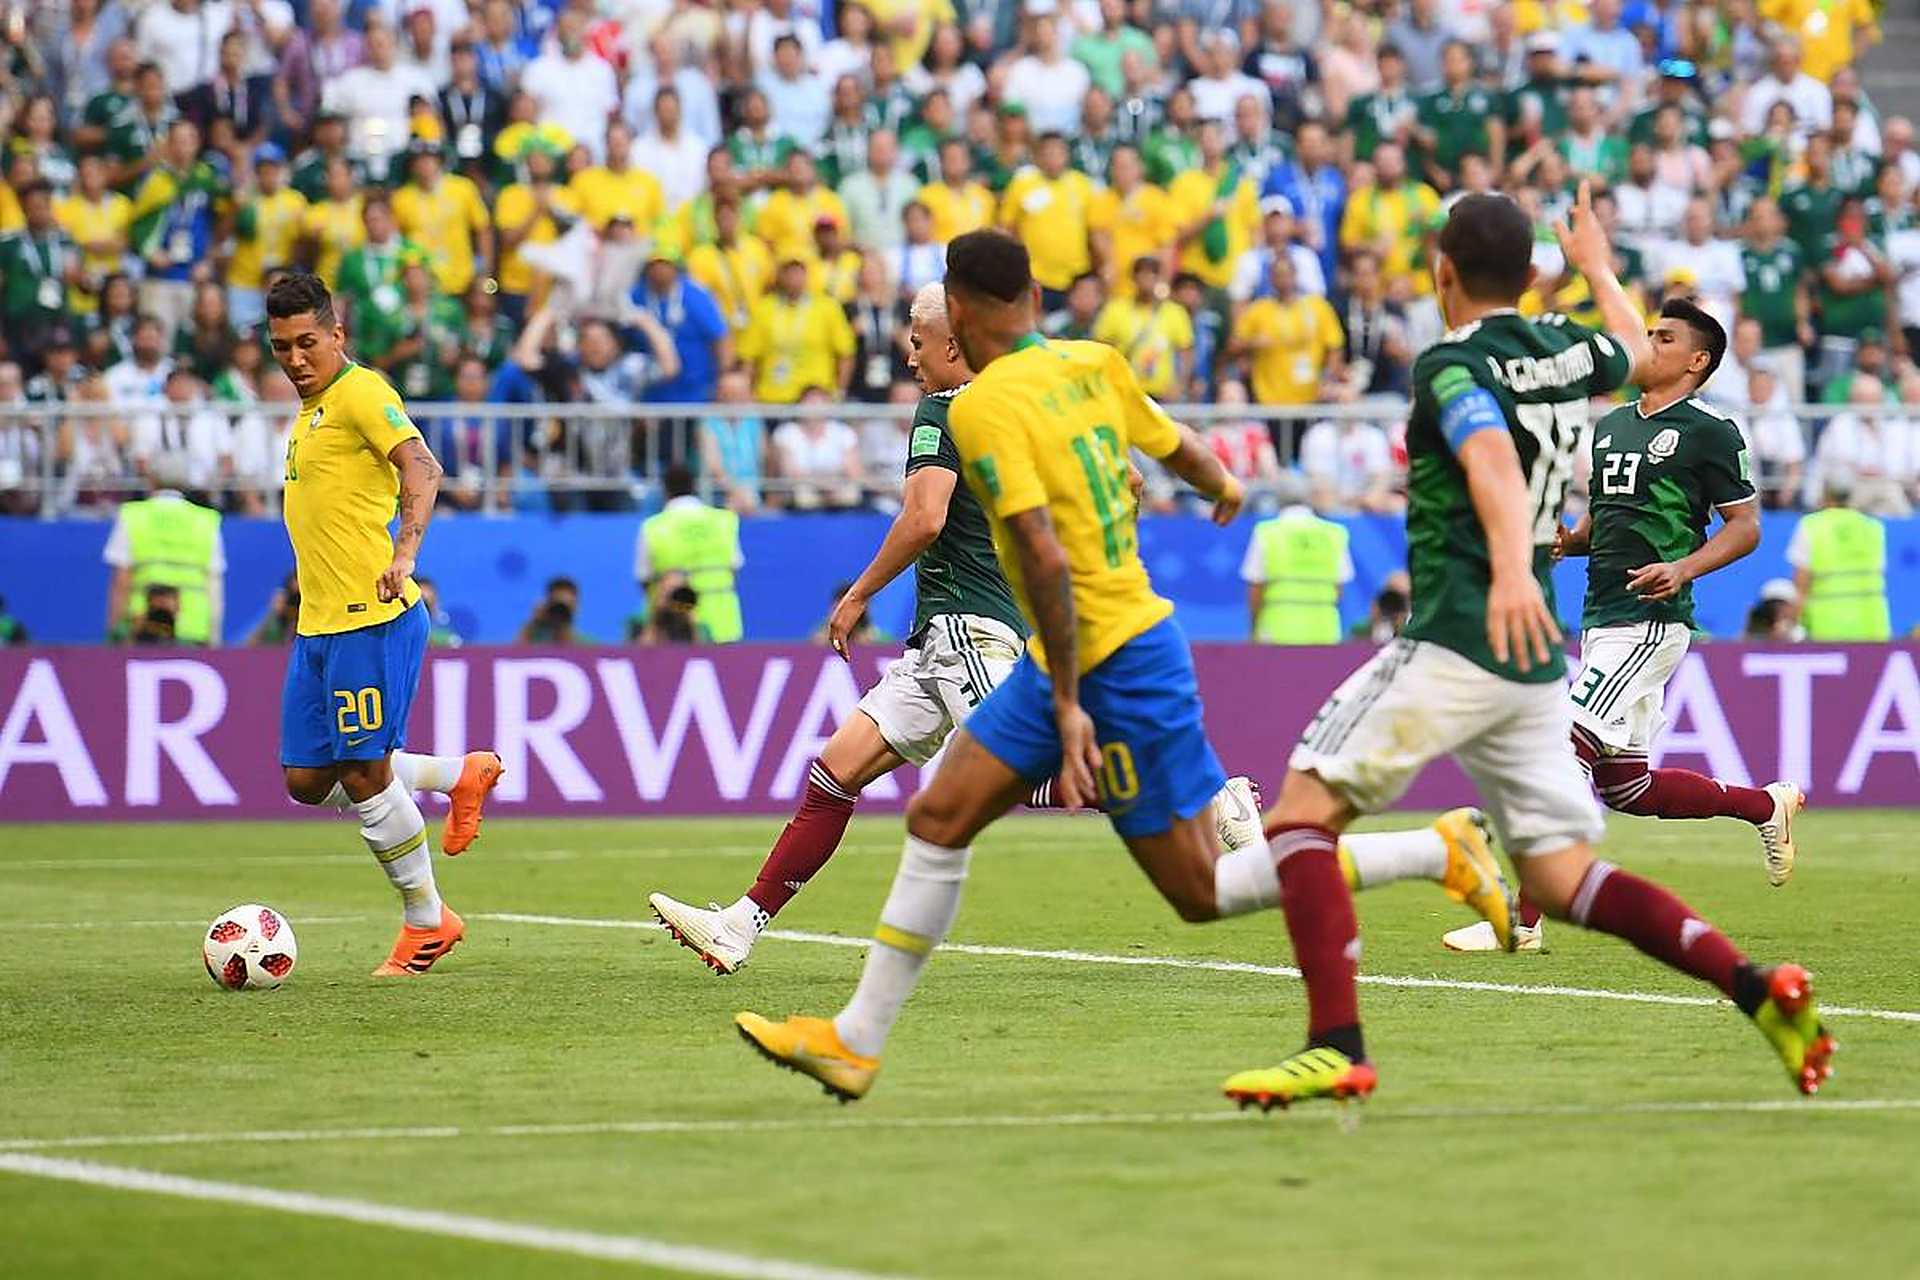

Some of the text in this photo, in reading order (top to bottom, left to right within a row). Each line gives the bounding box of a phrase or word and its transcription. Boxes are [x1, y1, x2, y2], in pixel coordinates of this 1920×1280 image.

[1602, 452, 1643, 495] 23
[334, 687, 383, 733] 20
[1646, 650, 1920, 794] ATA
